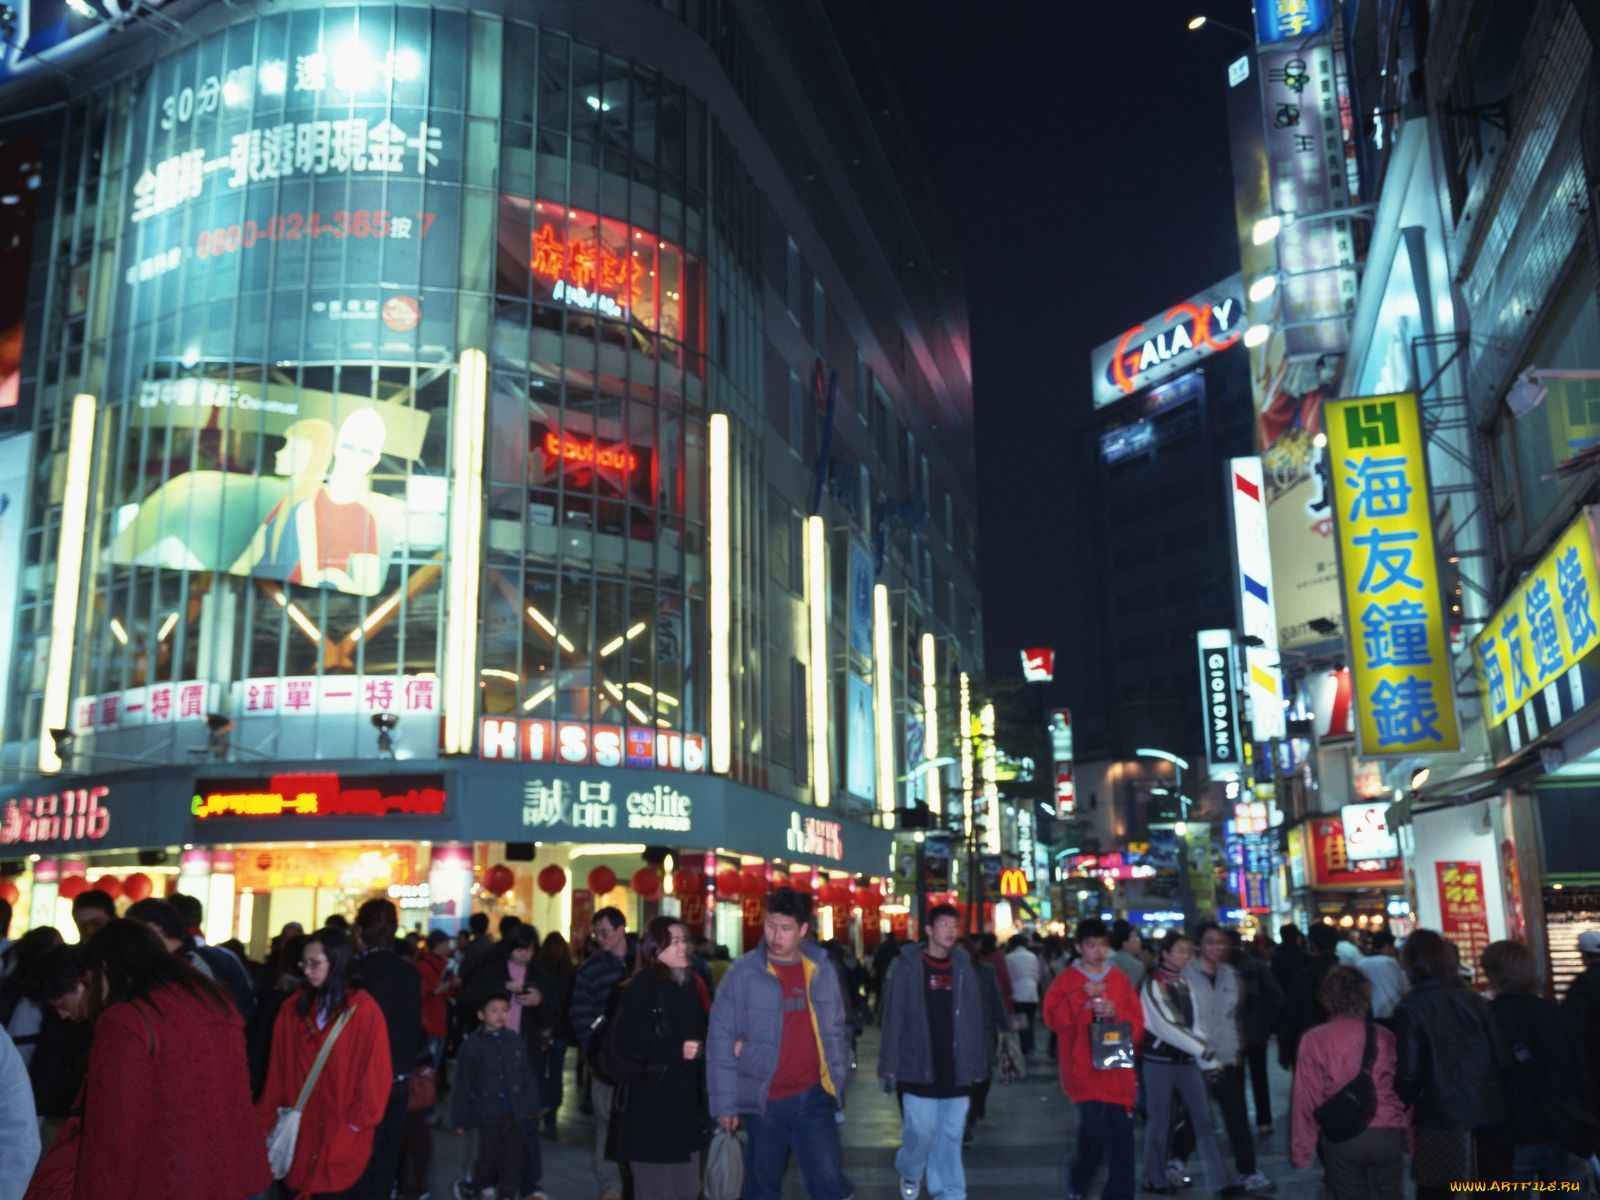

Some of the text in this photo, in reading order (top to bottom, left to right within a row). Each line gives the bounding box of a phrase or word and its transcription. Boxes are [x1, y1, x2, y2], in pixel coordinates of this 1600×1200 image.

[1113, 297, 1240, 394] GALAXY
[1344, 456, 1443, 746] 海友鐘錶
[1208, 652, 1230, 760] GIORDANO
[523, 778, 617, 829] 誠品
[626, 785, 692, 818] eslite
